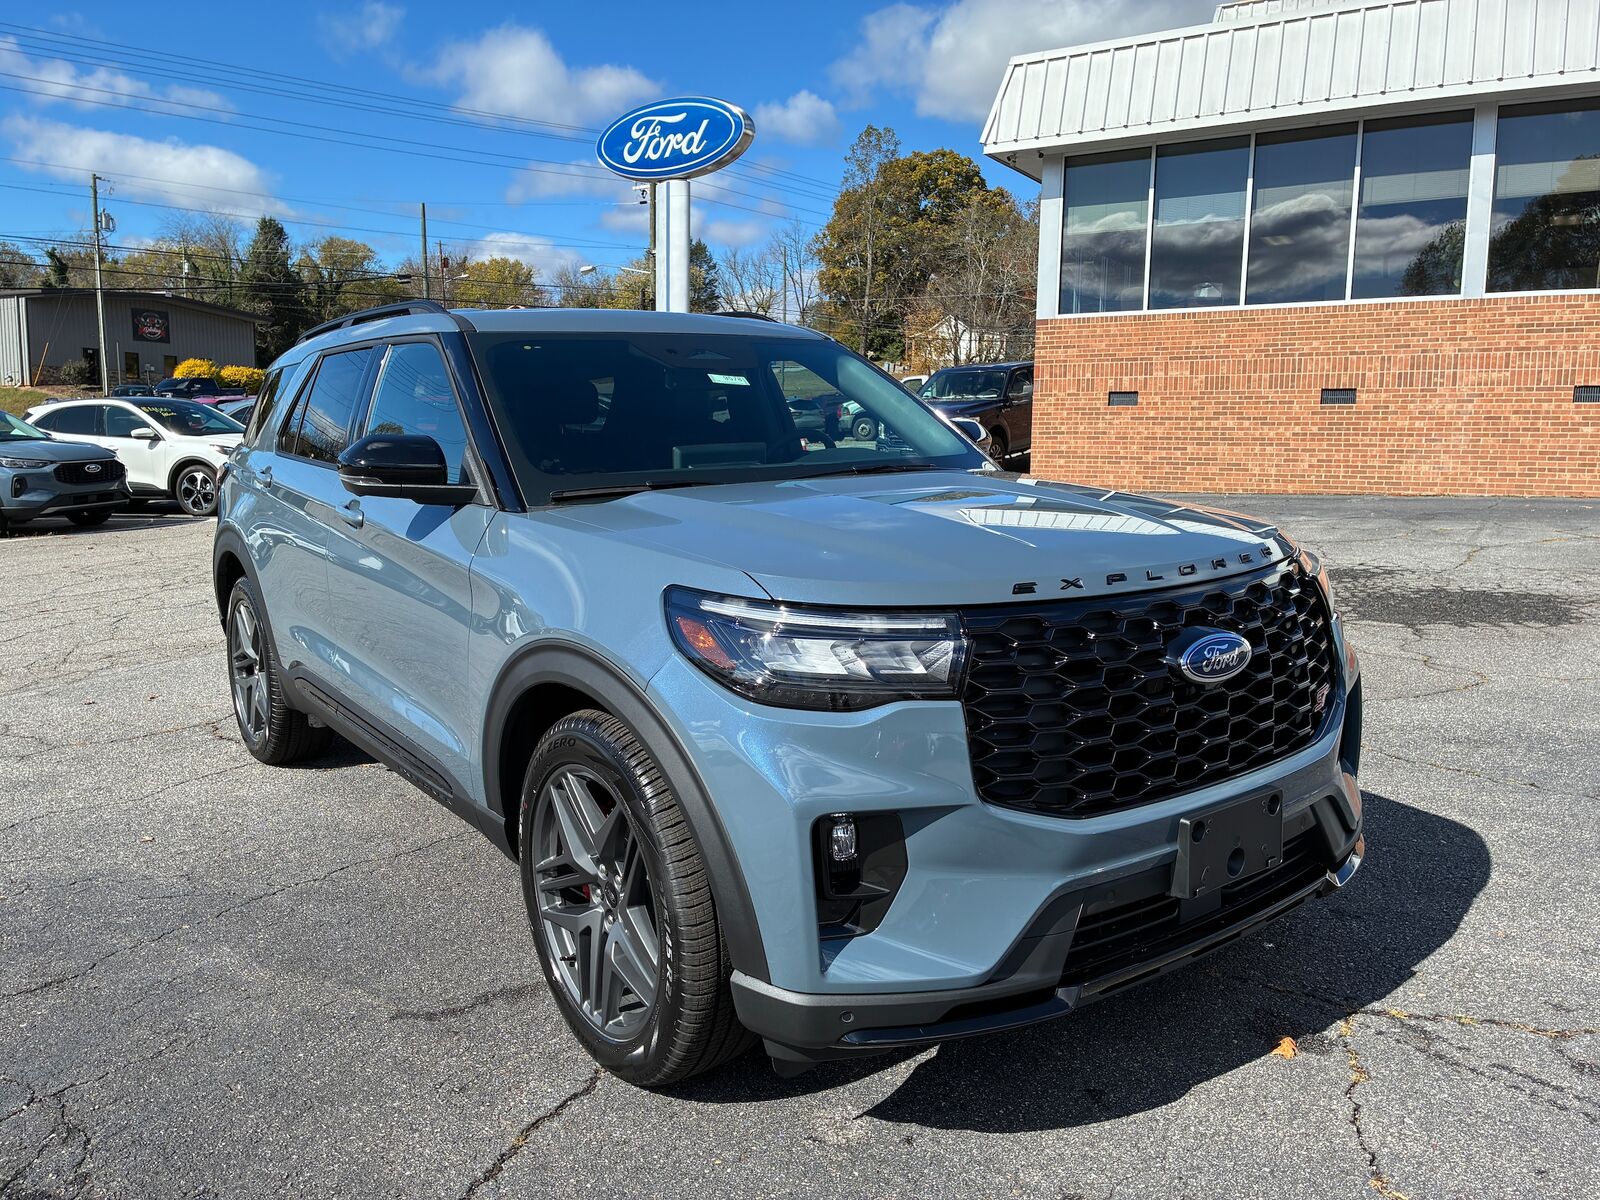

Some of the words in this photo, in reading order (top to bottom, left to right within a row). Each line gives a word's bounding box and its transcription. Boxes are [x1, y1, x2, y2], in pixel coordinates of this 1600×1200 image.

[623, 112, 710, 164] Ford
[1011, 545, 1274, 595] EXPLORER
[1202, 643, 1240, 673] Ford
[546, 737, 576, 753] ZERO
